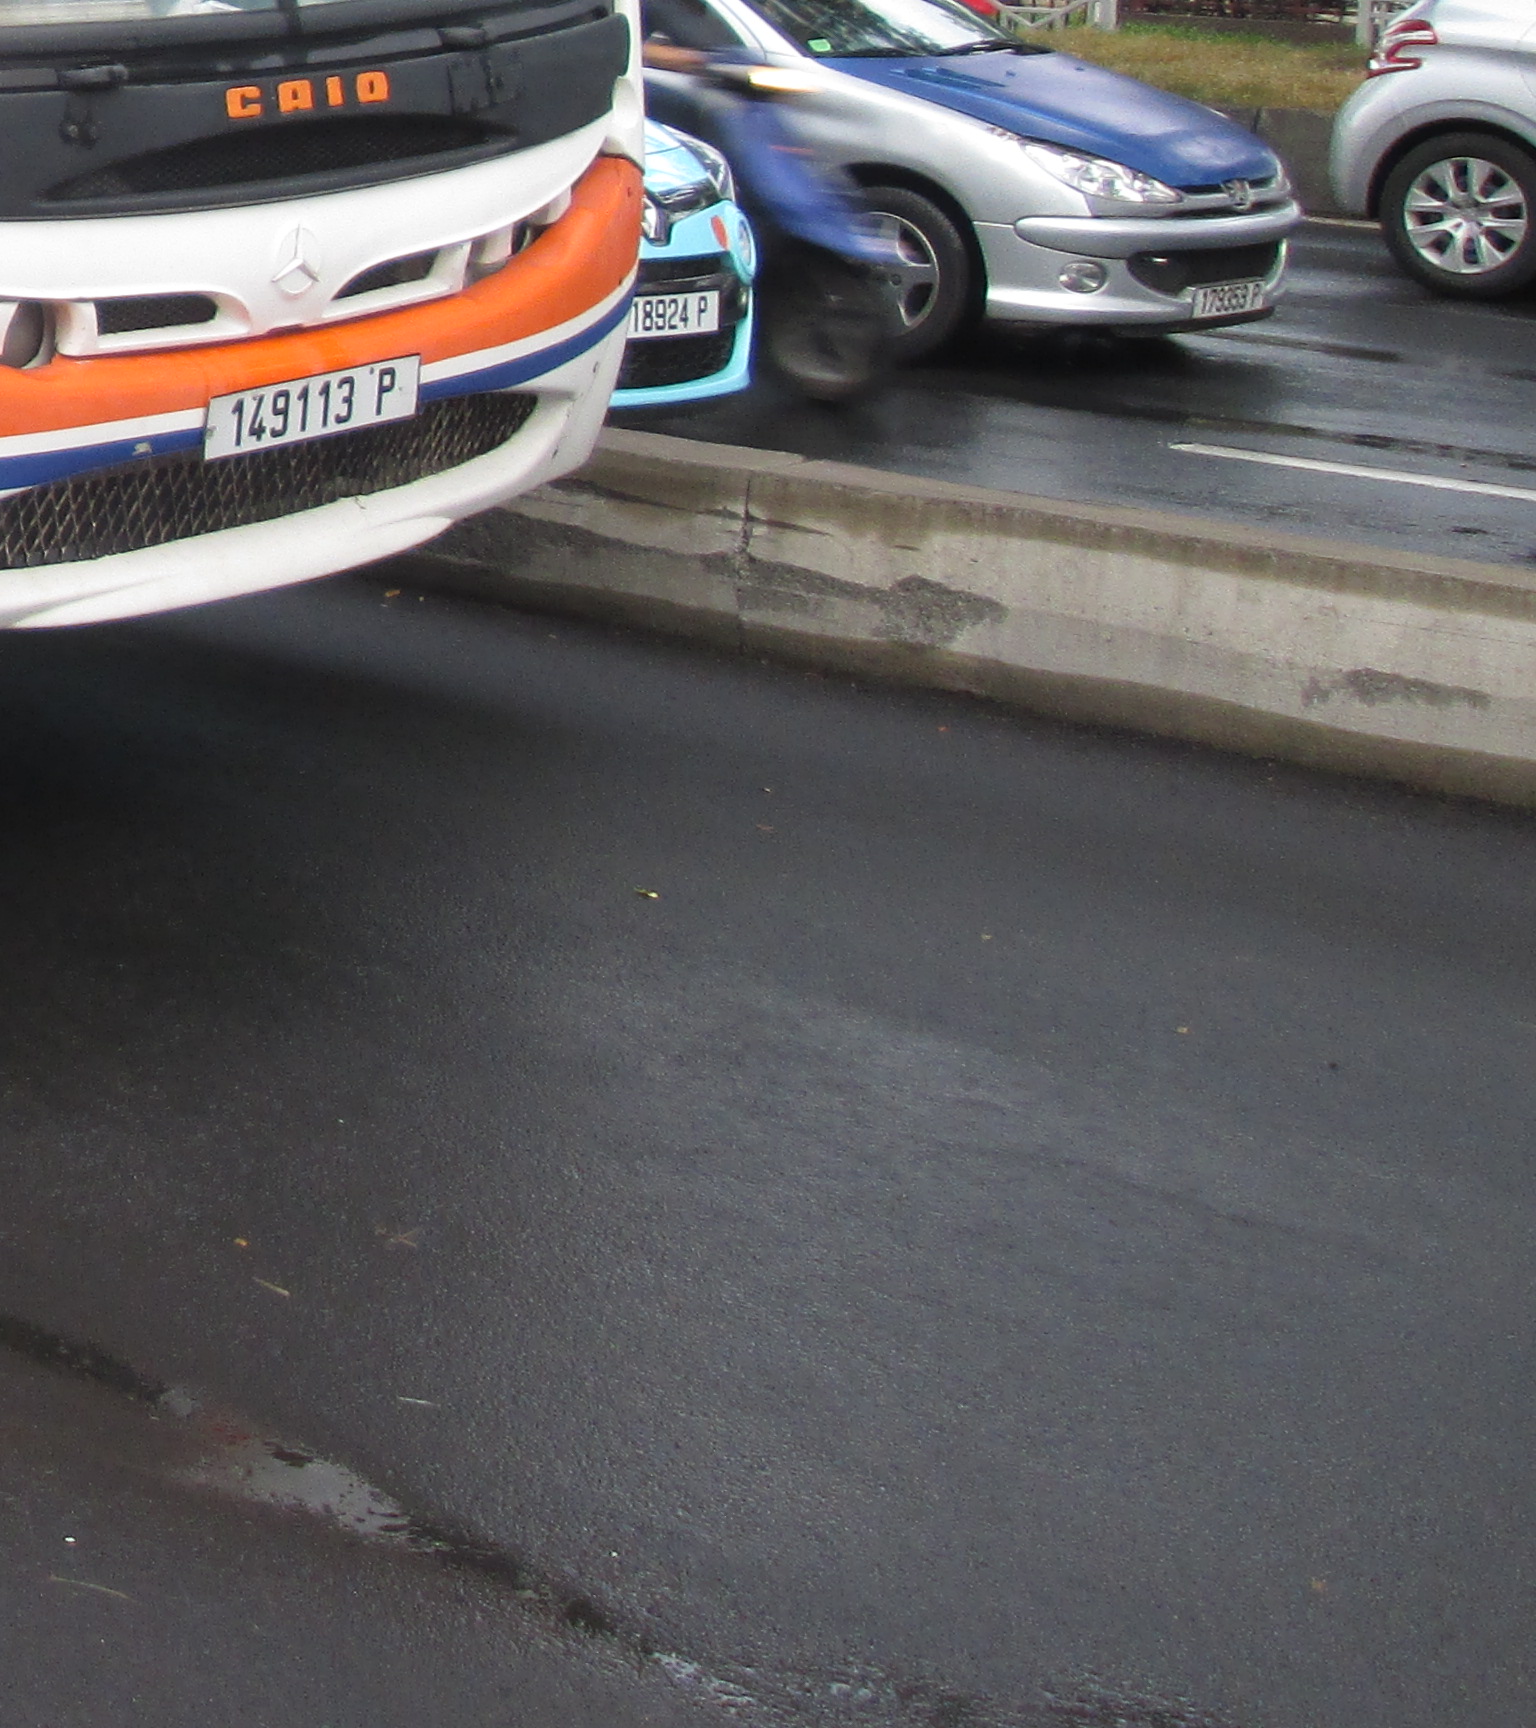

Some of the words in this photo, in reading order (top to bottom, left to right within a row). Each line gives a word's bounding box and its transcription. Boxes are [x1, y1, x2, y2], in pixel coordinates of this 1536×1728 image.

[225, 70, 391, 120] CAIO
[632, 297, 689, 333] 18924
[697, 295, 708, 327] P
[230, 375, 356, 447] 149113
[374, 366, 396, 417] P
